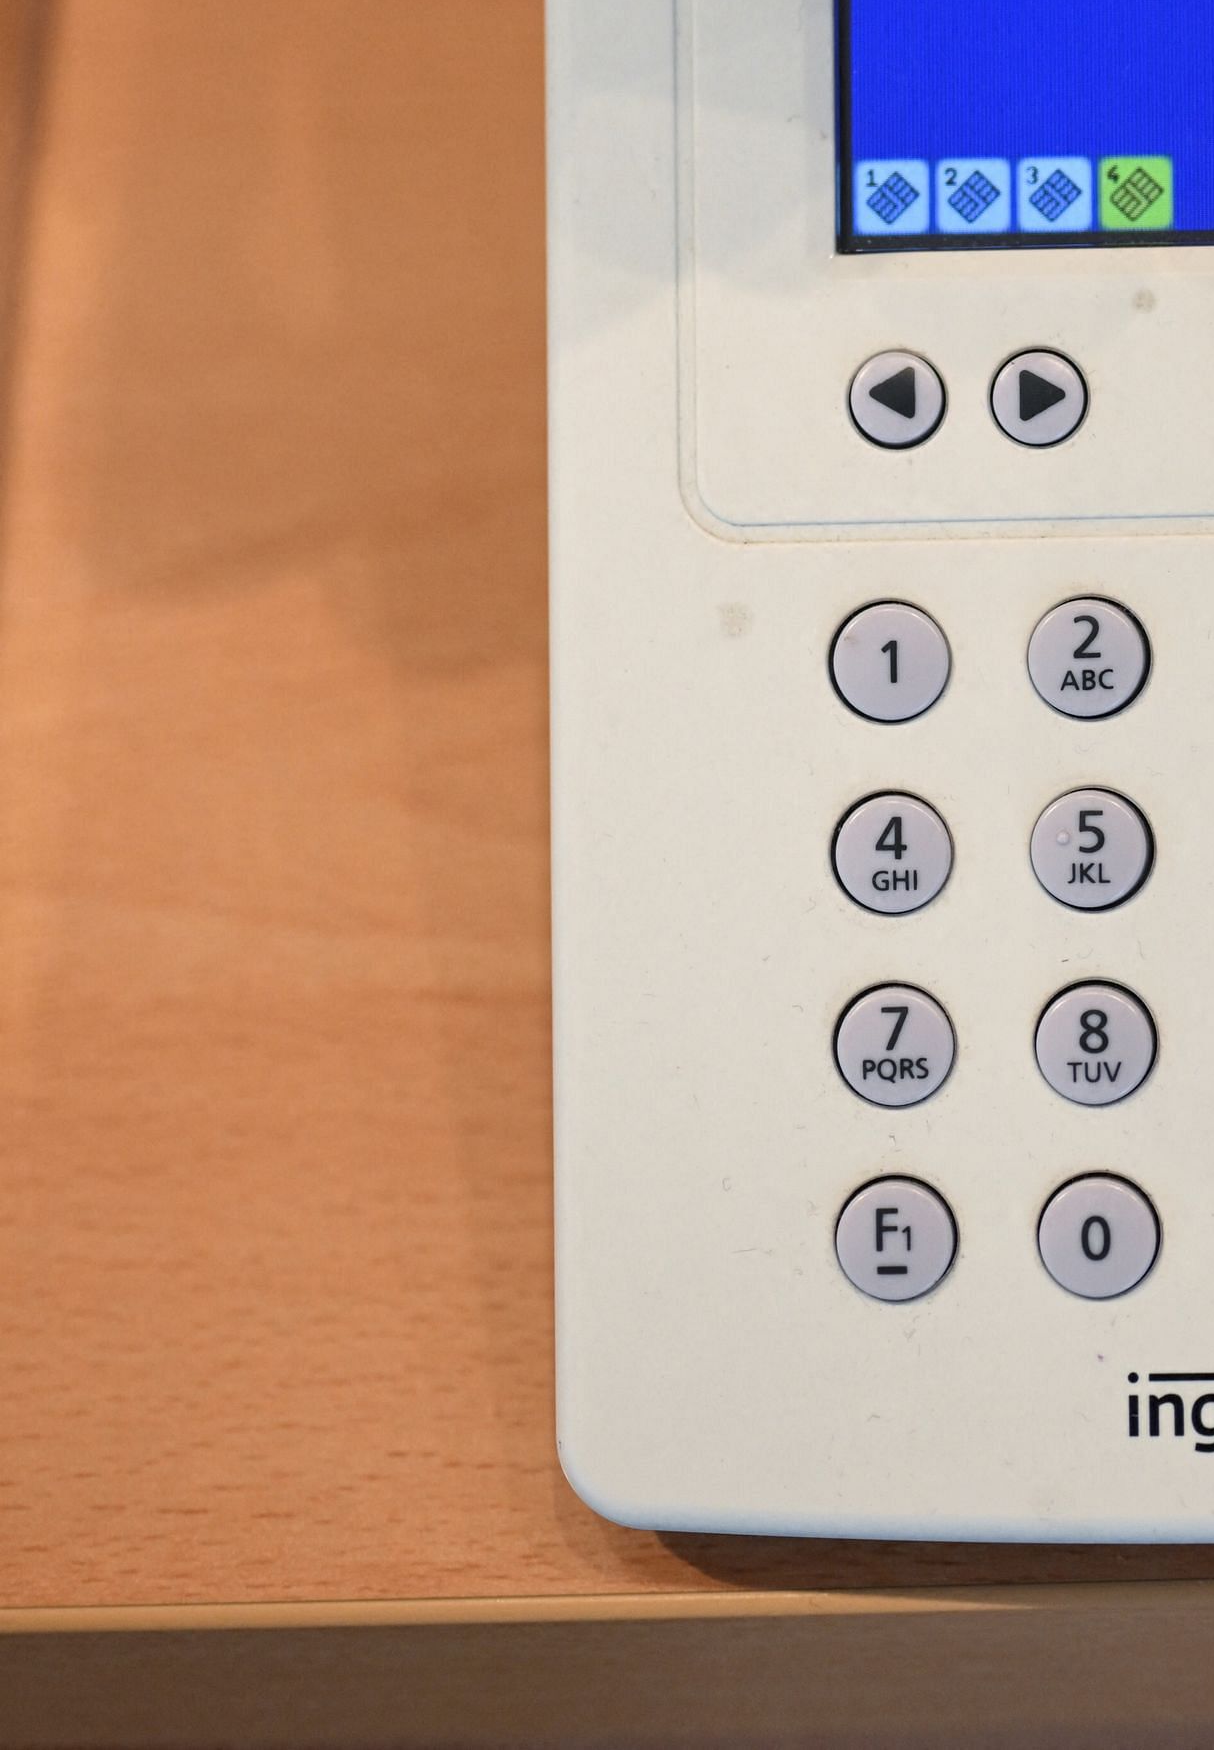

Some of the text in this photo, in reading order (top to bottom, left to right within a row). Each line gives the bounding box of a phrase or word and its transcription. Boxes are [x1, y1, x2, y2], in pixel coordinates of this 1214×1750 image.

[865, 168, 878, 187] 1
[944, 167, 958, 186] 2
[1025, 165, 1039, 185] 3
[1072, 614, 1102, 660] 2
[880, 640, 898, 684] 1
[1060, 668, 1115, 692] ABC
[875, 816, 908, 861] 4
[1078, 809, 1106, 854] 5
[871, 869, 919, 892] GHI
[1067, 862, 1111, 885] JKL
[880, 1005, 910, 1052] 7
[1078, 1008, 1110, 1055] 8
[862, 1057, 930, 1083] PQRS
[1066, 1061, 1123, 1084] TUV
[1080, 1215, 1112, 1263] 0
